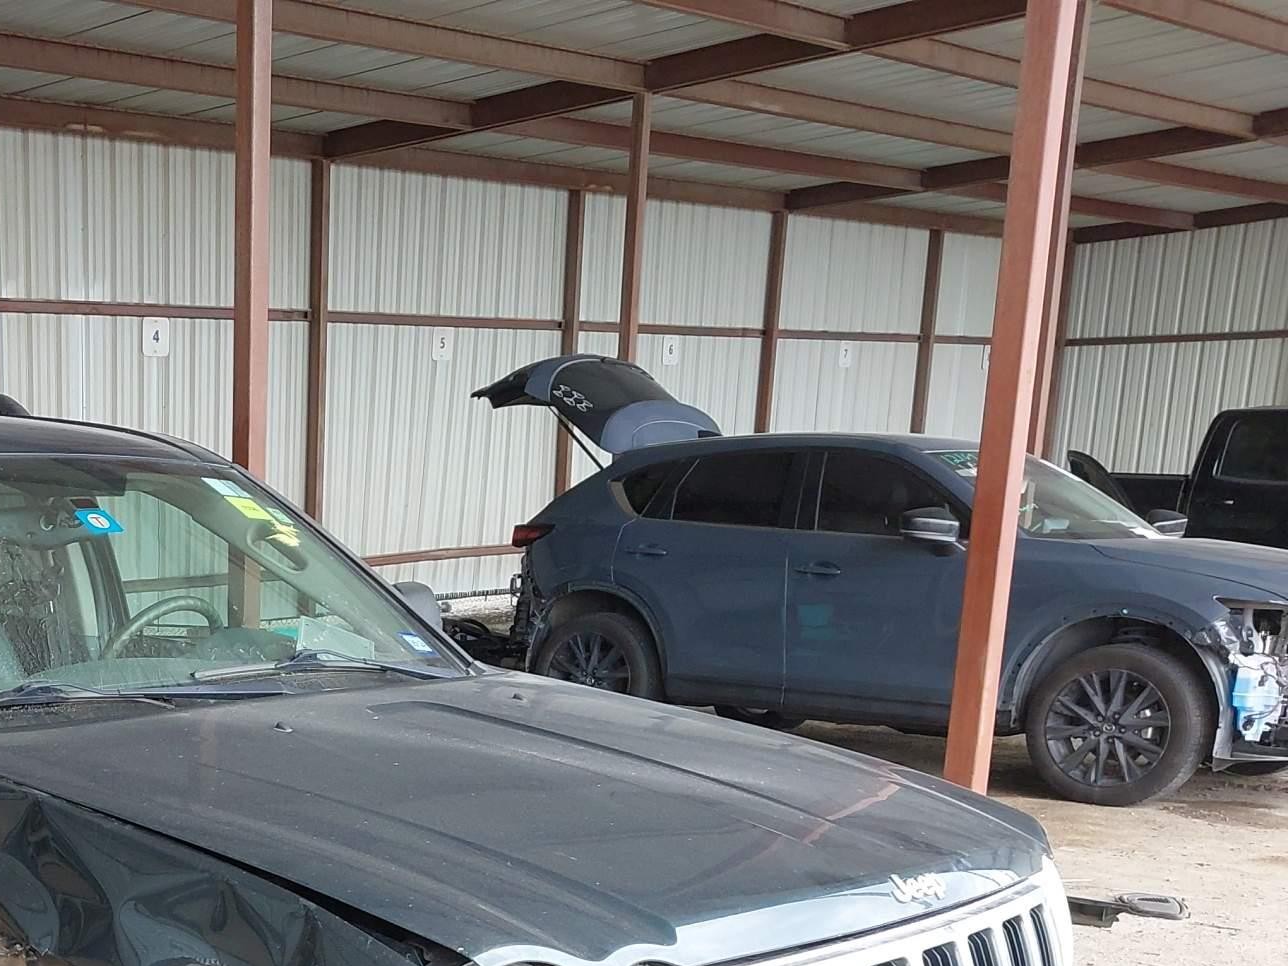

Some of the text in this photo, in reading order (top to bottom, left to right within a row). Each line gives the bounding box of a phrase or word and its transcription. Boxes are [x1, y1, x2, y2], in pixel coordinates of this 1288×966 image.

[152, 329, 160, 344] 4
[439, 336, 446, 350] 5
[668, 344, 674, 355] 6
[889, 872, 946, 906] Jeep
